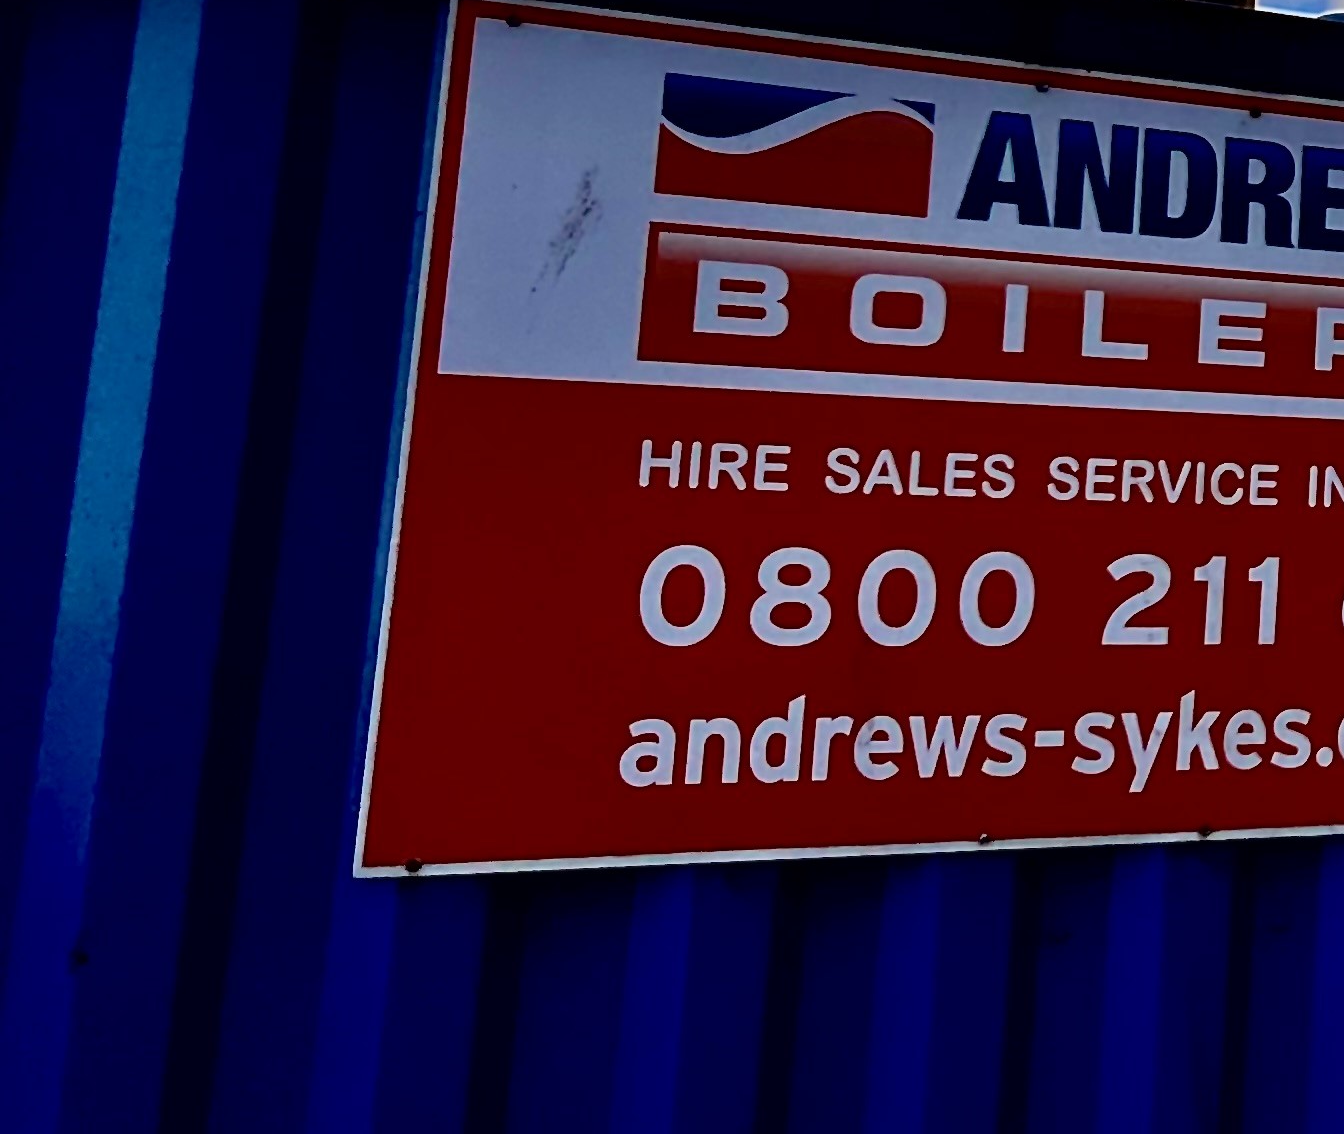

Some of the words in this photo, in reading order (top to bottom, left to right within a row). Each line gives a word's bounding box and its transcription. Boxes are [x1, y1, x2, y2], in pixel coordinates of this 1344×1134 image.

[639, 440, 791, 491] HIRE
[824, 448, 1015, 498] SALES
[1048, 456, 1279, 506] SERVICE
[640, 545, 1035, 646] 0800
[1102, 553, 1280, 646] 211
